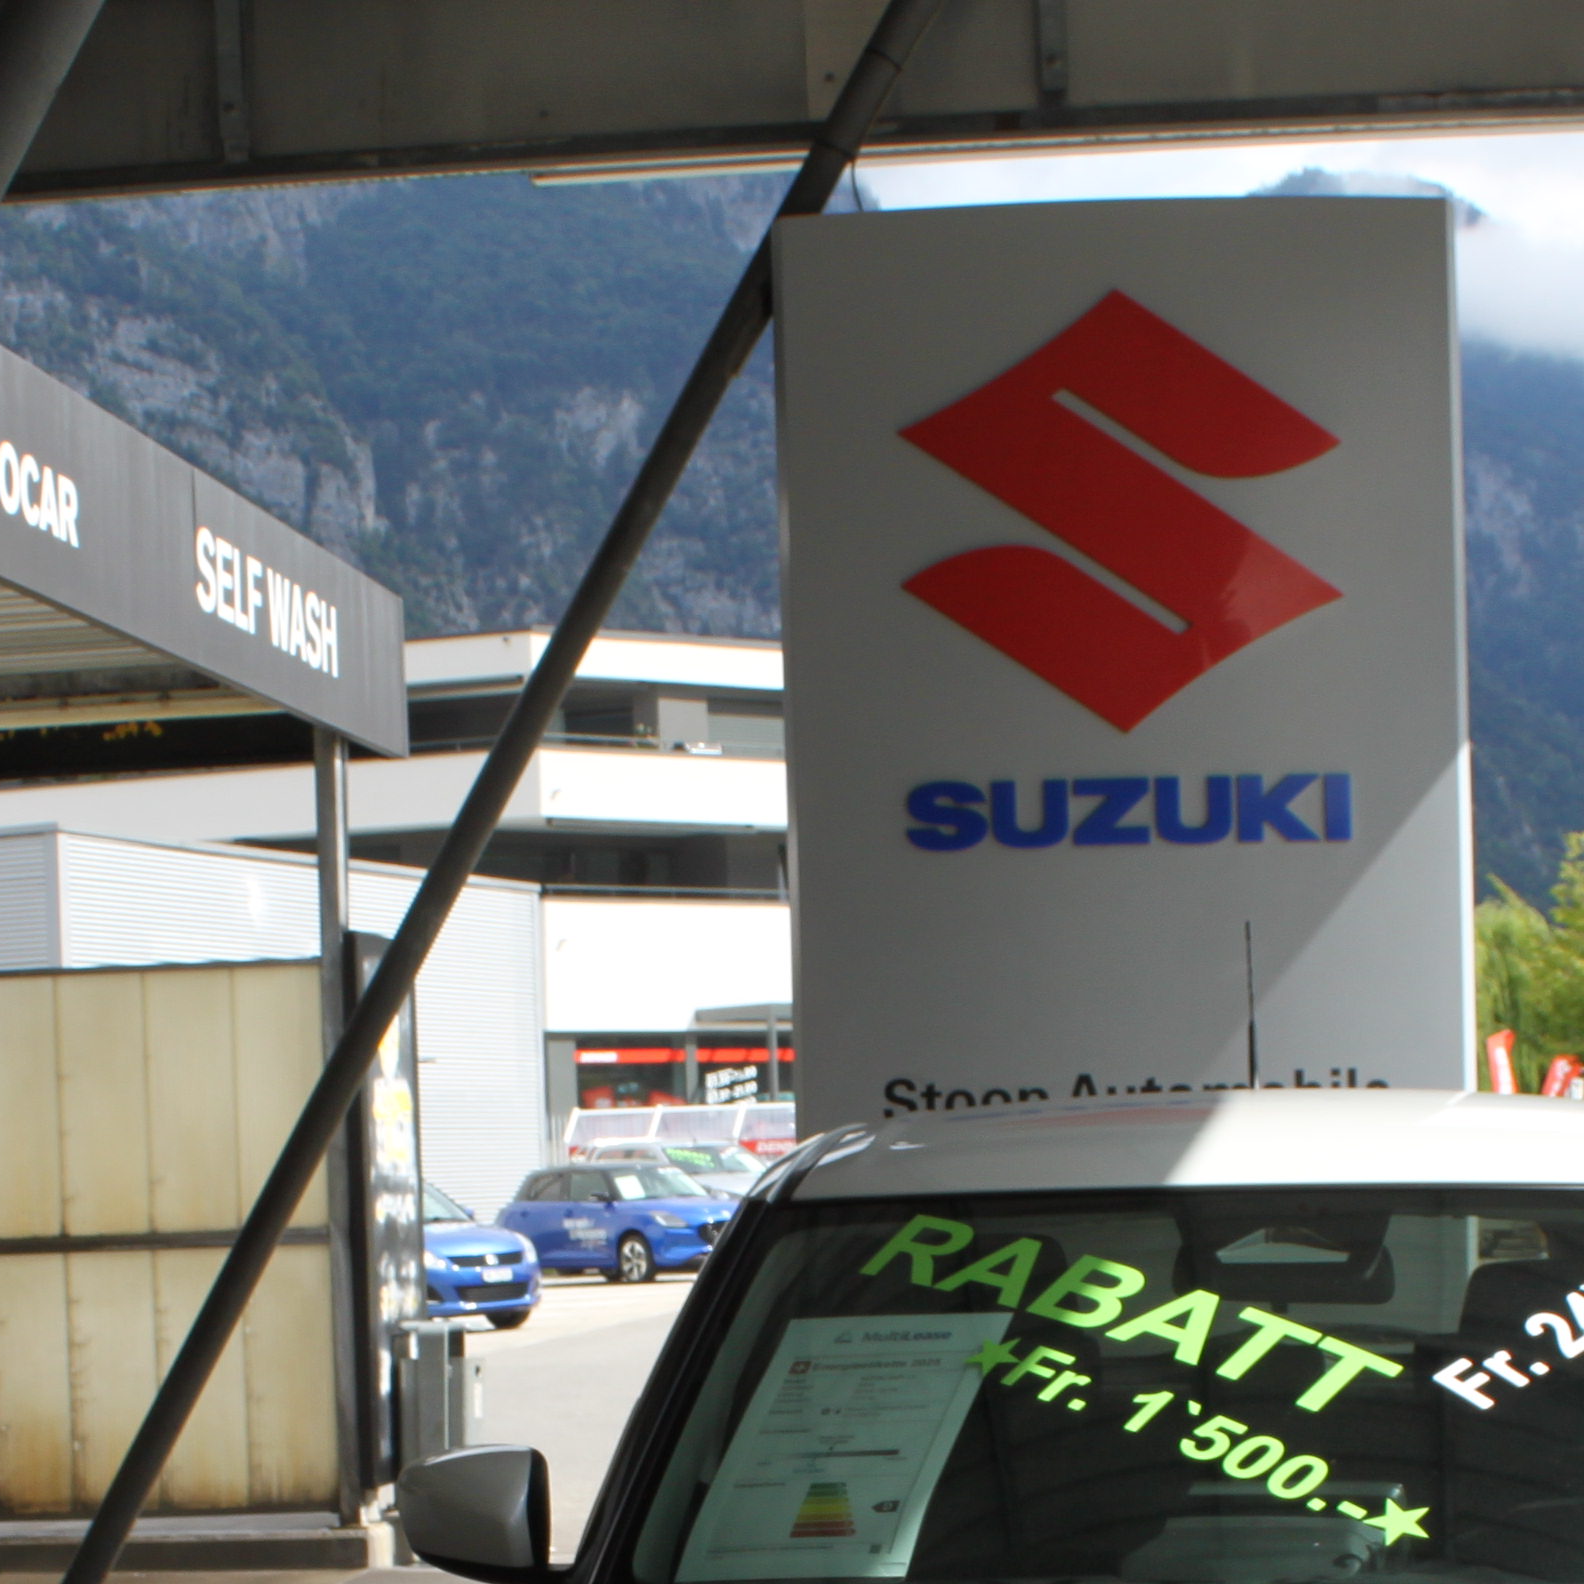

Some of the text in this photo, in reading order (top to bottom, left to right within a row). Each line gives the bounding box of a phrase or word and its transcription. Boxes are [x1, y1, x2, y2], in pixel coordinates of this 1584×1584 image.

[195, 525, 340, 679] SELF WASH
[904, 772, 1353, 851] SUZUKI
[859, 1213, 1404, 1412] RABATT
[1000, 1345, 1092, 1411] Fr.
[1432, 1356, 1549, 1410] Fr.
